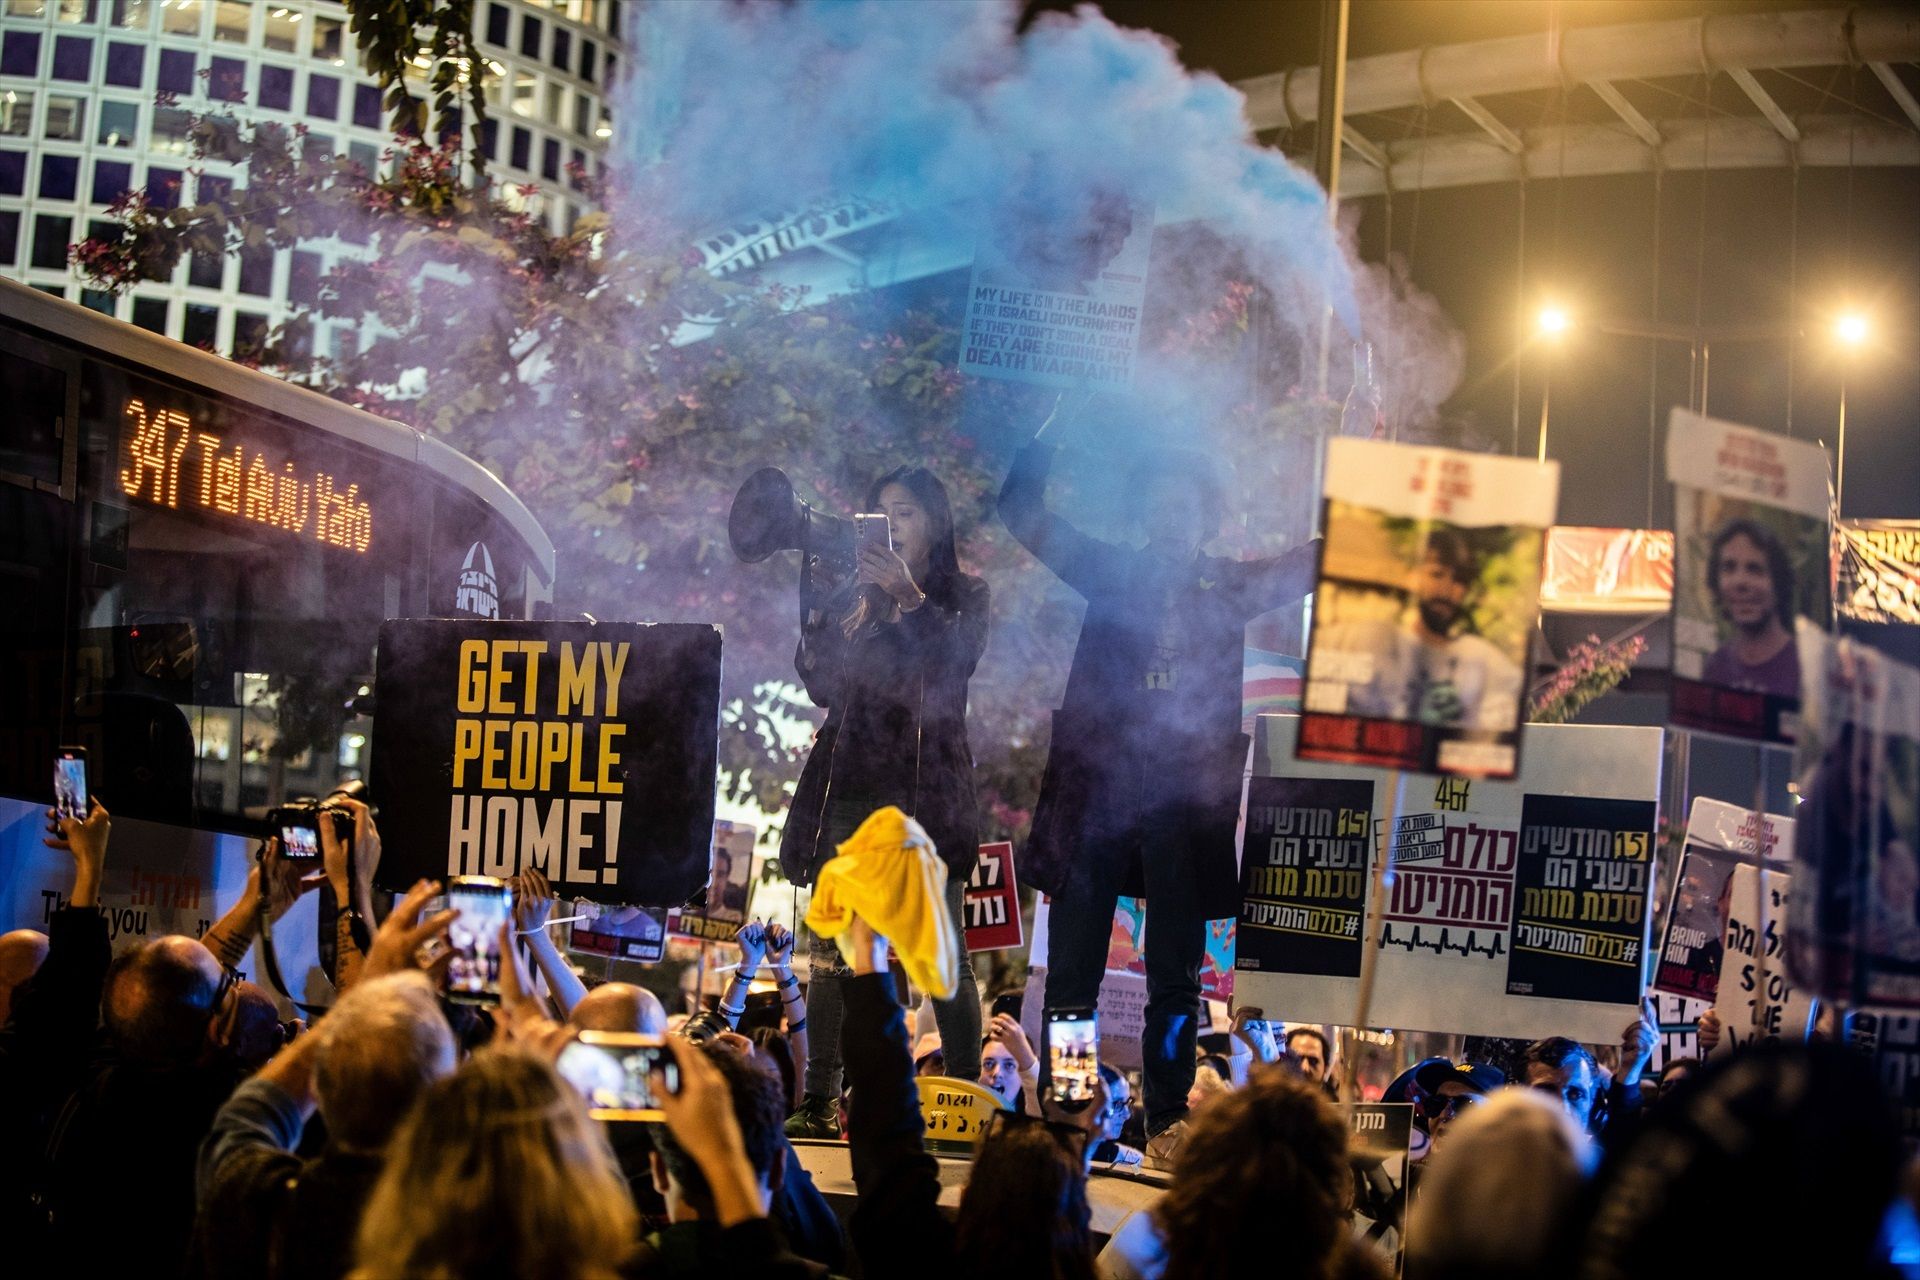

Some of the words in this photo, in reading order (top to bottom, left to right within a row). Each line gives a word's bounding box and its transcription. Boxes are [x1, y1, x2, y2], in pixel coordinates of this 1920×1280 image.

[973, 303, 982, 315] OF
[983, 304, 997, 317] THE
[998, 306, 1048, 323] ISRAELI
[1050, 311, 1135, 333] GOVERNMENT
[975, 287, 998, 301] MY
[999, 290, 1031, 306] LIFE
[1034, 294, 1043, 308] IS
[1056, 296, 1085, 312] THE
[1087, 301, 1138, 319] HANDS
[969, 332, 1008, 348] THEY
[1011, 336, 1041, 354] ARE
[1045, 342, 1105, 361] SIGNING
[1107, 350, 1130, 365] MY
[971, 318, 982, 331] IF
[984, 321, 1017, 335] THEY
[1019, 325, 1055, 340] DON'T
[1056, 329, 1086, 344] SIGN
[1087, 333, 1096, 345] A
[1099, 335, 1133, 351] DEAL
[966, 348, 1027, 371] DEATH
[1031, 356, 1129, 383] WARRANT!
[120, 399, 191, 509] 347
[198, 433, 243, 514] Tel
[245, 453, 310, 533] Aviv
[315, 472, 372, 553] Yafo
[458, 640, 549, 715] GET
[556, 641, 632, 718] MY
[452, 719, 627, 795] PEOPLE
[1249, 806, 1334, 837] חודשים
[1340, 809, 1369, 838] 15
[447, 794, 623, 885] HOME!
[1268, 836, 1301, 866] הם
[1306, 838, 1364, 869] בשבי
[1421, 843, 1443, 858] למען
[1442, 822, 1519, 872] כולם
[1523, 825, 1612, 859] חודשים
[1615, 831, 1645, 861] 15
[130, 866, 201, 910] תודה!
[1247, 866, 1299, 897] מוות
[1303, 868, 1362, 900] סכנת
[1544, 857, 1578, 888] הם
[1584, 860, 1645, 893] בשבי
[1521, 887, 1576, 919] מוות
[1580, 890, 1643, 925] סכנת
[110, 906, 149, 941] you
[1669, 924, 1707, 950] BRING
[1665, 943, 1691, 966] HIM
[937, 1092, 974, 1107] 01241
[1355, 1112, 1386, 1133] מתן
